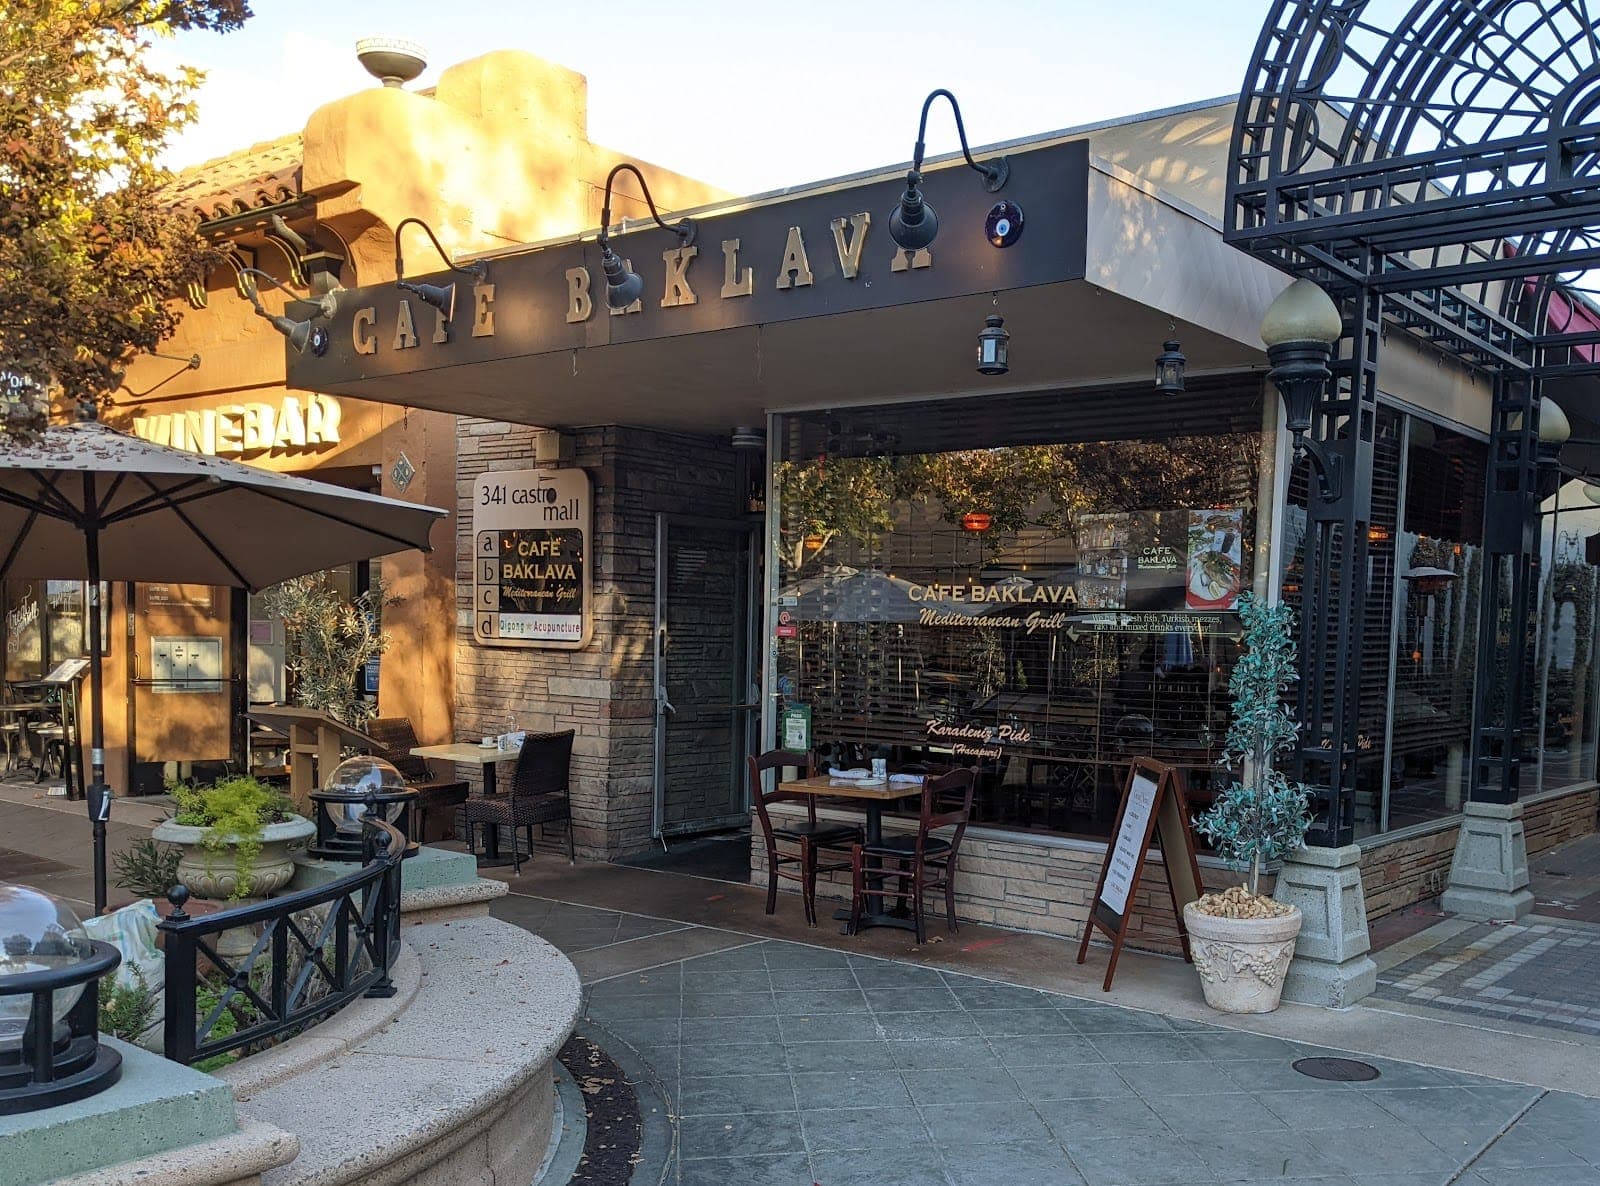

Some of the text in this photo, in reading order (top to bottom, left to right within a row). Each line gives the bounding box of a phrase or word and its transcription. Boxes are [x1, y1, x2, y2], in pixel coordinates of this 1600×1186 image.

[565, 211, 932, 324] BKLAV
[481, 483, 557, 506] 341 castro
[543, 499, 579, 521] mall
[483, 536, 493, 552] a
[518, 541, 561, 556] CAFE
[1143, 547, 1171, 555] CAFE
[1137, 556, 1177, 564] BAKLAVA
[484, 561, 494, 581] b
[503, 564, 576, 580] BAKLAVA
[484, 590, 492, 604] c
[556, 587, 577, 602] Grill
[908, 585, 1078, 604] CAFE BAKLAVA
[481, 614, 493, 635] d
[919, 608, 1066, 635] Mediterranean Grill
[1149, 622, 1174, 631] drinks
[1162, 614, 1190, 623] Turkish
[533, 621, 580, 634] Acupuncture
[998, 724, 1031, 742] Pide
